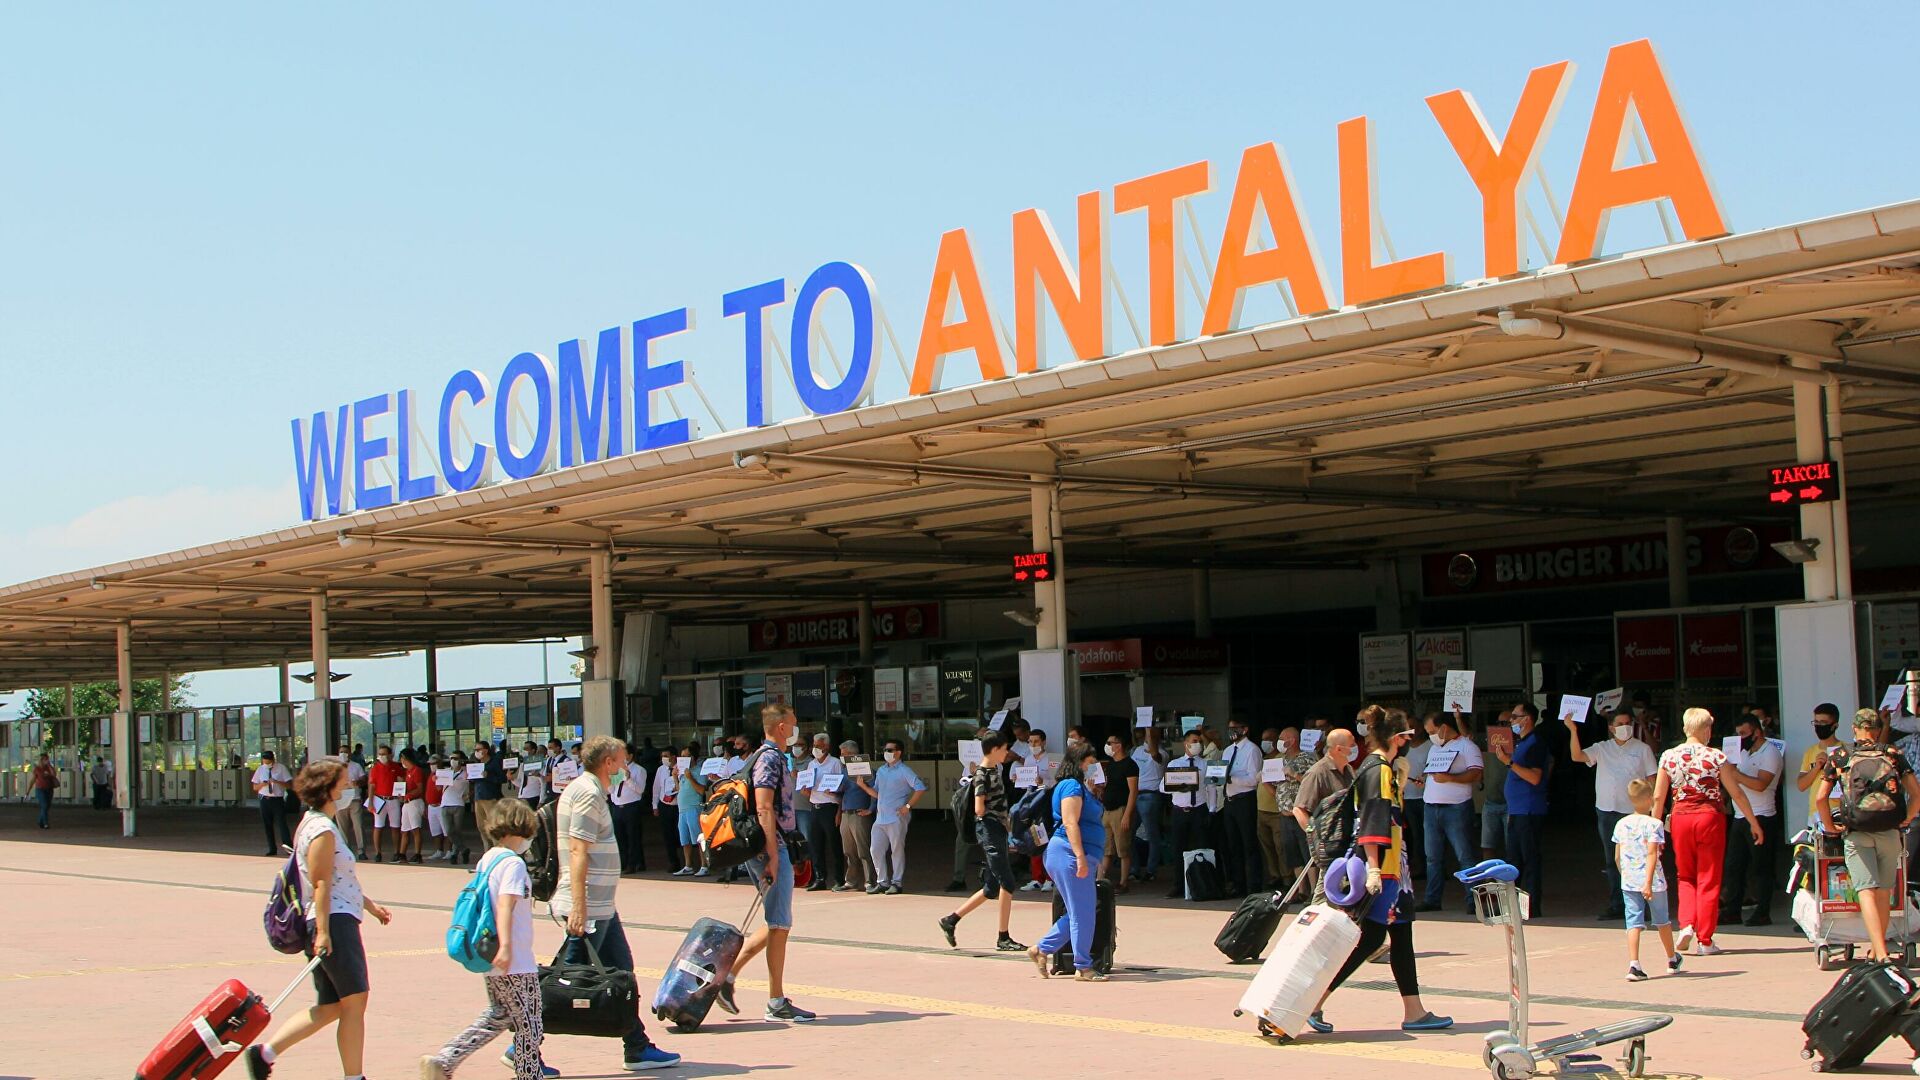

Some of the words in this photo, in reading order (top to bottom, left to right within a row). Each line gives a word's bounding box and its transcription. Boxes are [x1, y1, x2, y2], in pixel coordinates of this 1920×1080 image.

[291, 308, 693, 521] WELCOME
[723, 261, 877, 427] TO
[909, 39, 1731, 395] ANTALYA
[1772, 463, 1831, 485] ТАКСИ
[1496, 545, 1615, 582] BURGER
[787, 617, 849, 643] BURGER
[1076, 647, 1126, 665] odafone
[797, 688, 822, 697] FISCHER
